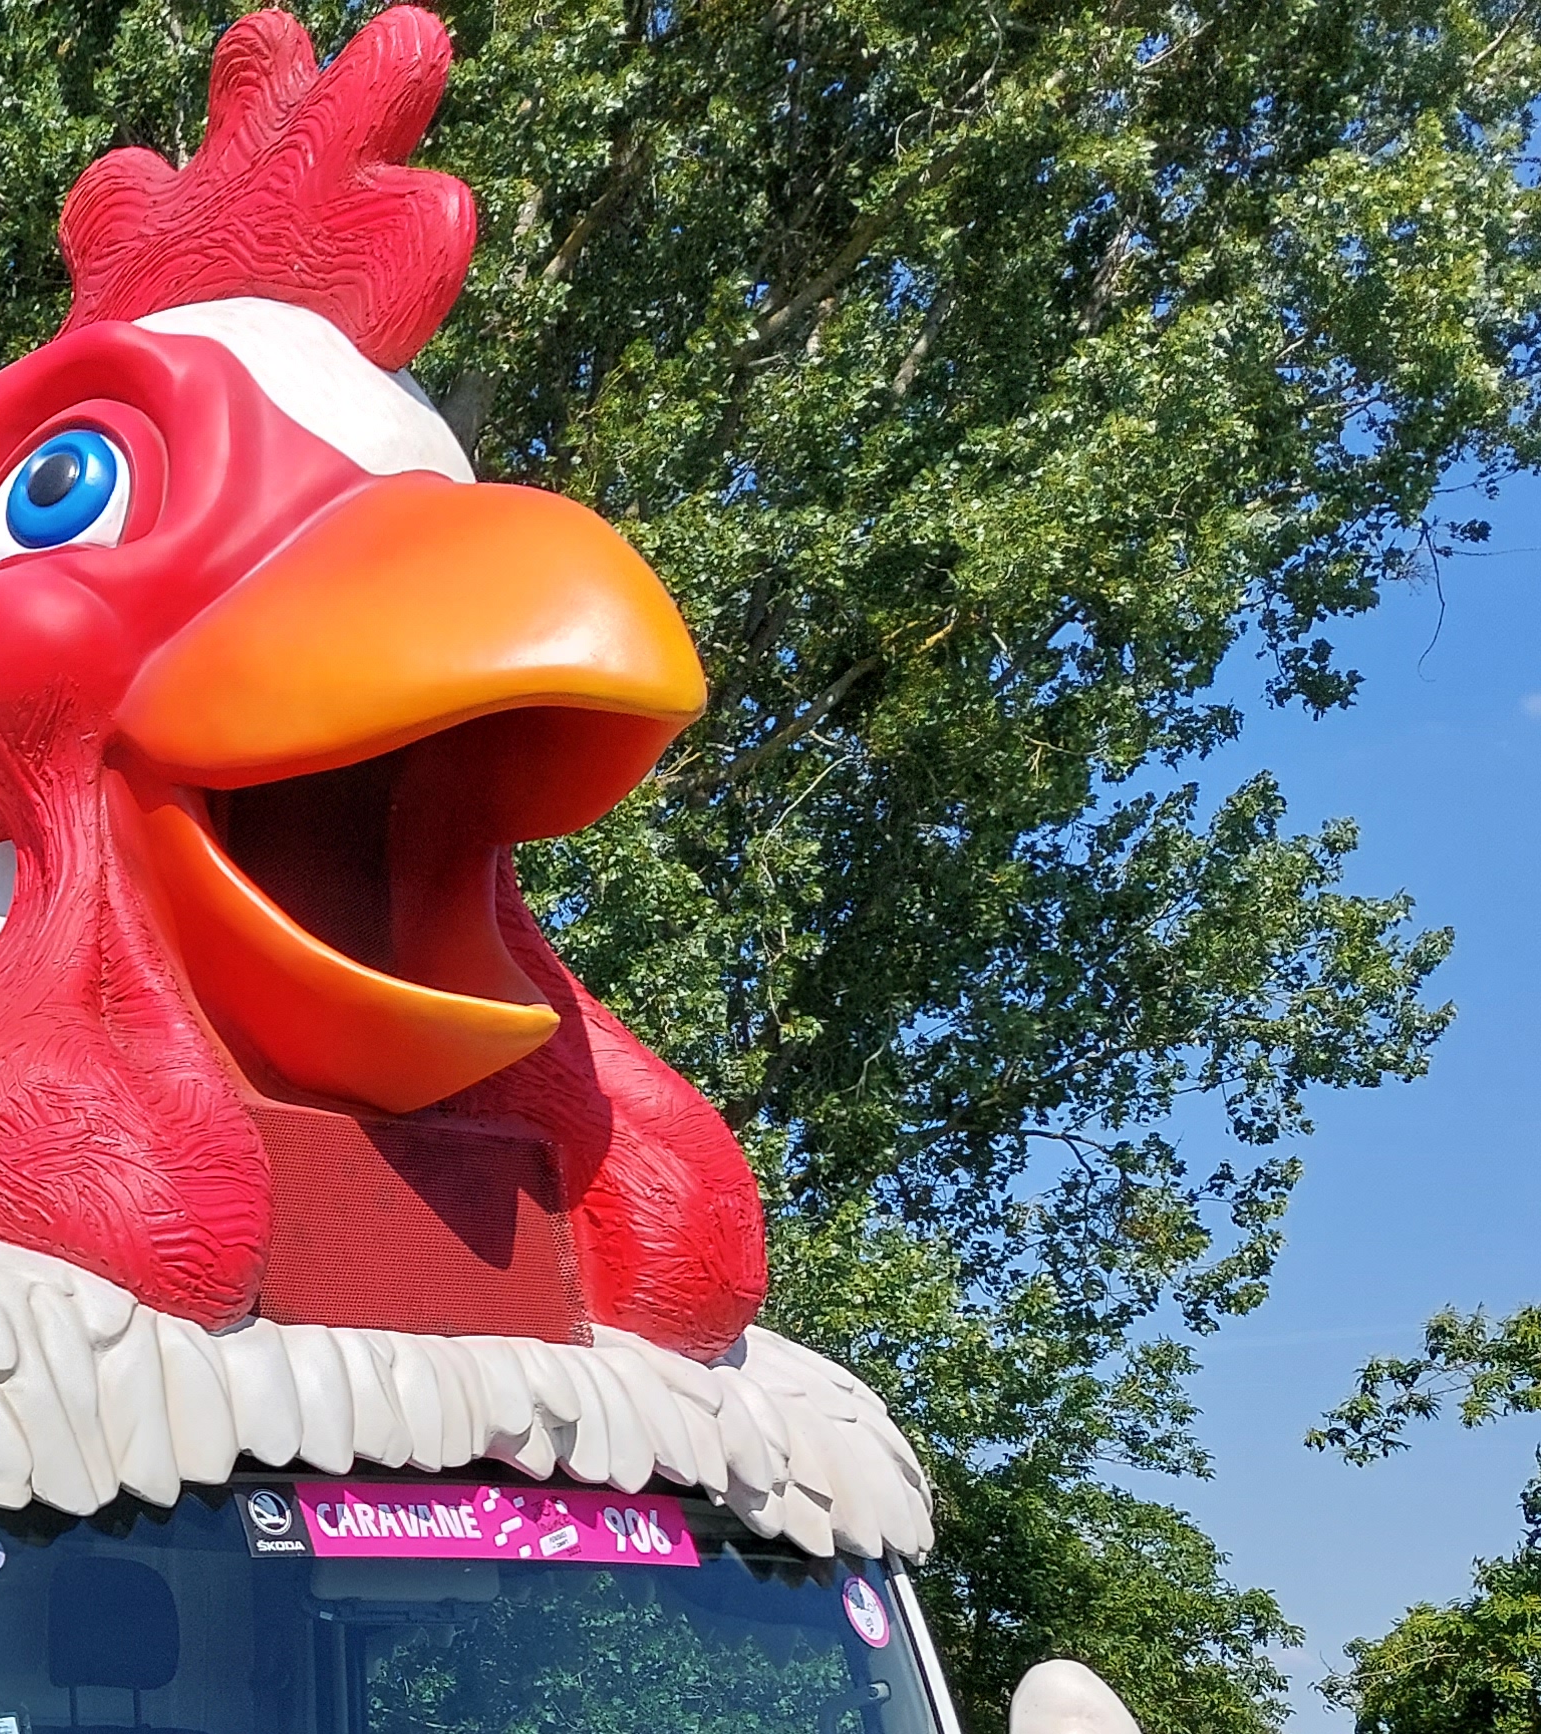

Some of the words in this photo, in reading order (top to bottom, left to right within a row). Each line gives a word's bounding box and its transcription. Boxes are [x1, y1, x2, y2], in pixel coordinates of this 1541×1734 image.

[316, 1502, 483, 1539] CARAVANE
[603, 1506, 672, 1555] 906
[256, 1538, 305, 1552] ŠKODA
